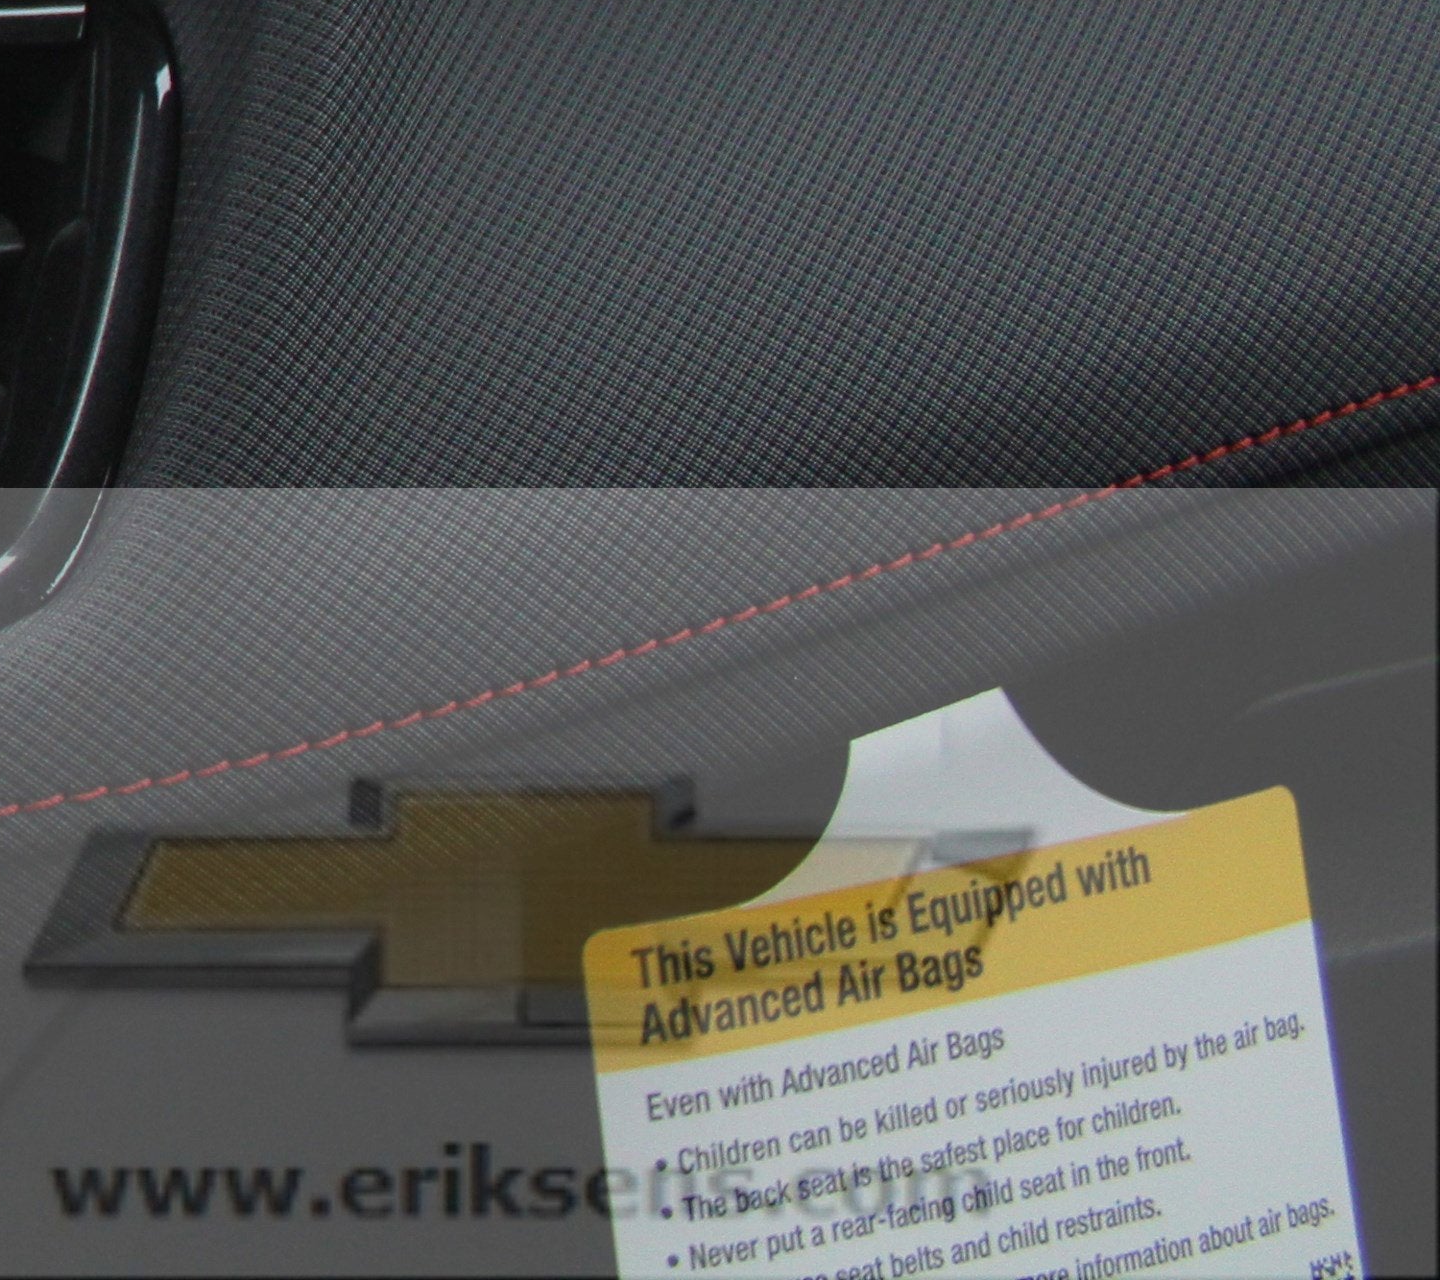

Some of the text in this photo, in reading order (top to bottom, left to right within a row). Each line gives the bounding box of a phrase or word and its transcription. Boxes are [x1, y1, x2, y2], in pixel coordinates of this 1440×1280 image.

[632, 846, 1151, 989] This Vehicle is Equipped with
[642, 944, 984, 1046] Advanced Air Bags
[646, 1026, 1005, 1122] Even with Advanced Air Bags
[676, 1011, 1305, 1175] Children can be killed or seriously injured by the air bag.
[682, 1094, 1182, 1222] The back seat is the safest place for children.
[689, 1137, 1192, 1271] Never put a rear-facing child seat in the front.
[835, 1195, 1162, 1280] seat belts and child restraints.
[1075, 1234, 1194, 1280] information
[1198, 1215, 1255, 1254] about
[1258, 1207, 1283, 1238] air
[1285, 1195, 1336, 1230] bags.
